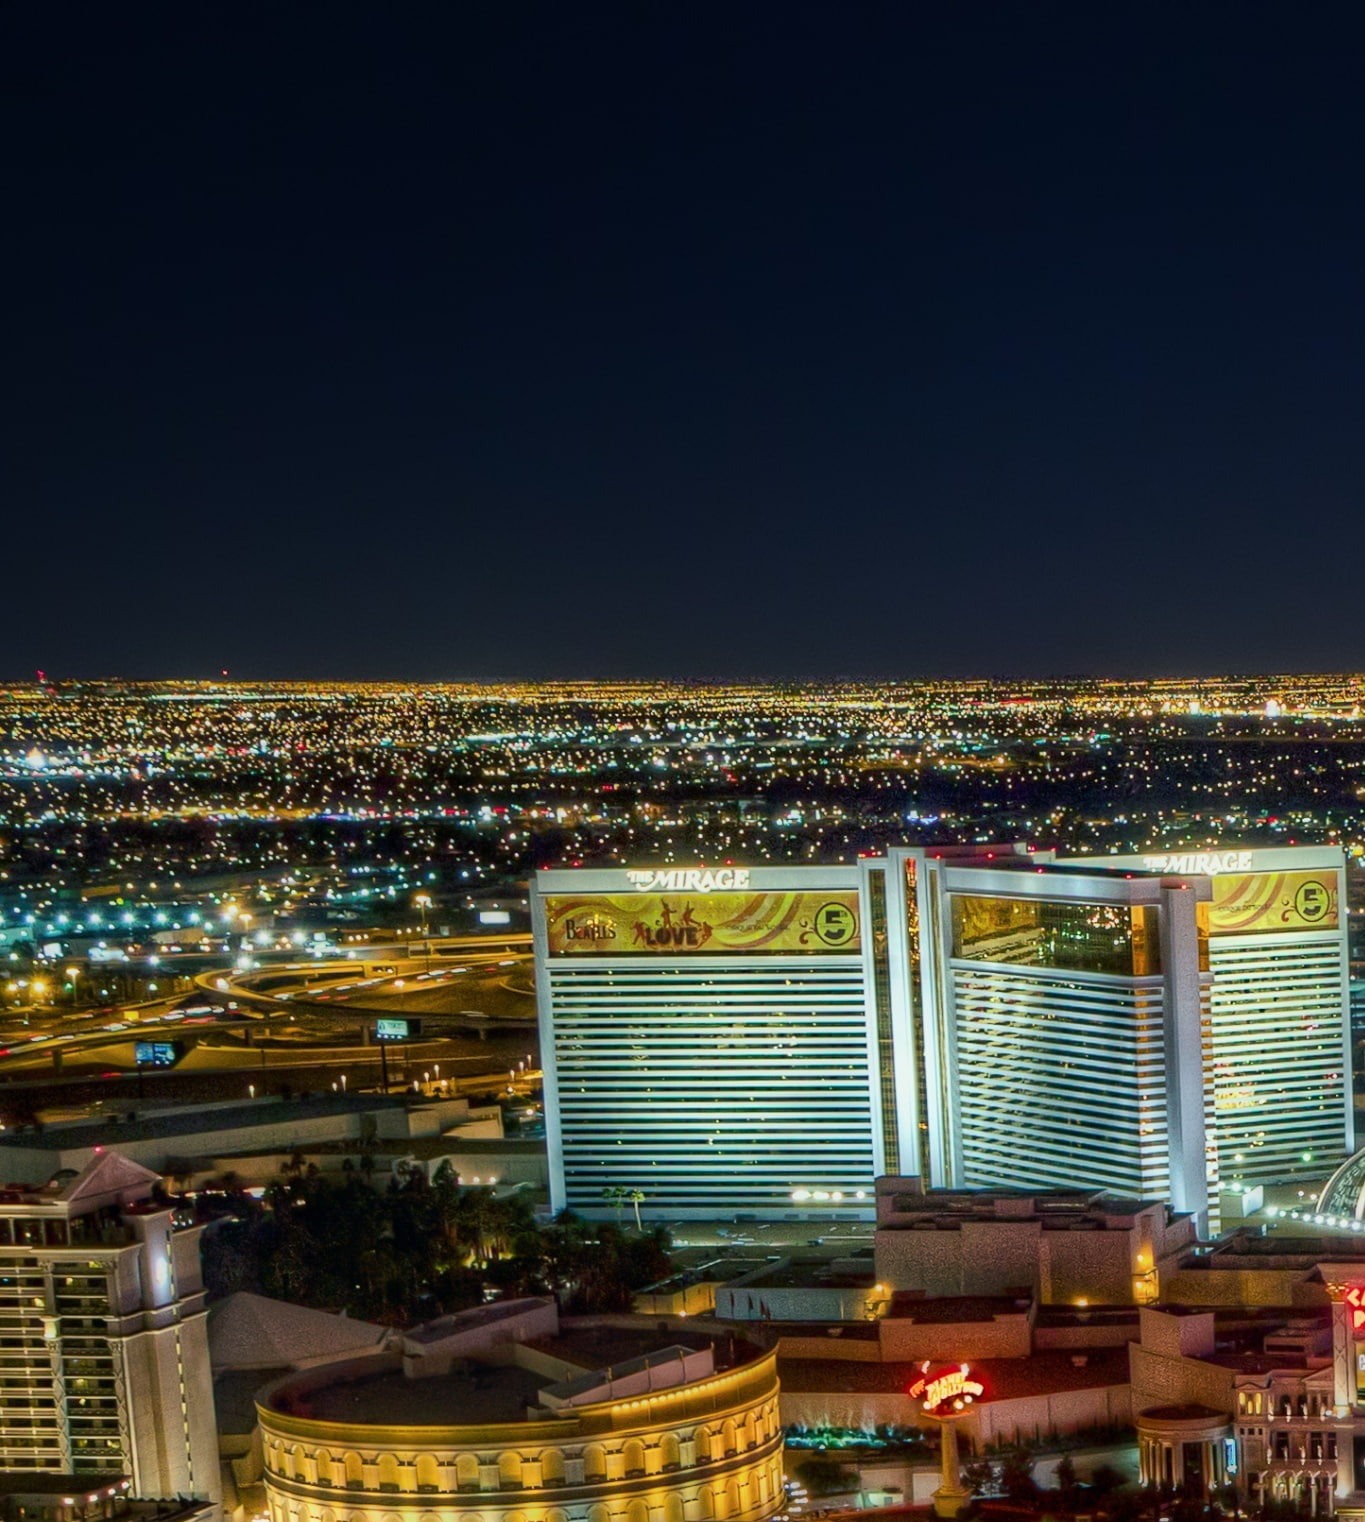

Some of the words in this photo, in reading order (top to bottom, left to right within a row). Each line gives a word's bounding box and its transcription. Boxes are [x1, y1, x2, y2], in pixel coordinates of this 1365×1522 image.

[1163, 852, 1252, 875] MIRAGE
[626, 871, 655, 884] THE
[635, 870, 749, 892] MIRAGE
[646, 926, 698, 946] LOVE
